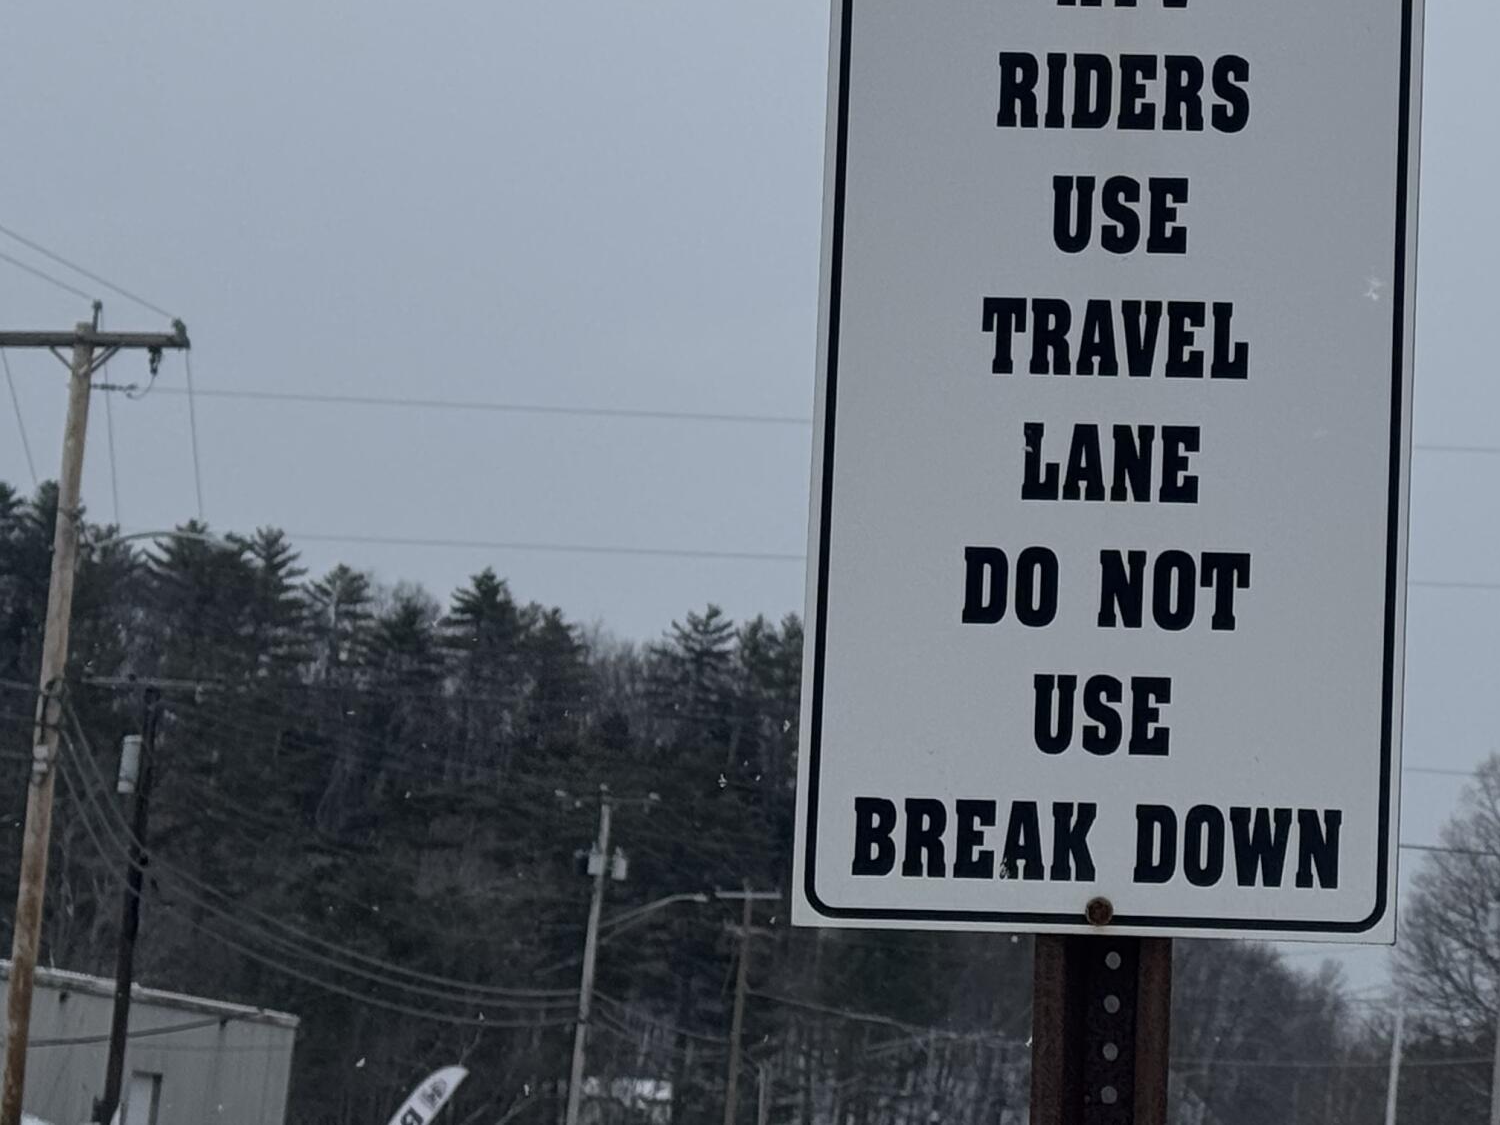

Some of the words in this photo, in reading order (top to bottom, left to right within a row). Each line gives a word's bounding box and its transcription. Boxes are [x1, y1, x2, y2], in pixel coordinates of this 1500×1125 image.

[996, 51, 1250, 134] RIDERS
[1052, 175, 1189, 255] USE
[981, 296, 1249, 380] TRAVEL
[1021, 422, 1201, 504] LANE
[961, 546, 1059, 628] DO
[1097, 549, 1251, 631] NOT
[1033, 673, 1172, 757] USE
[851, 796, 1097, 882] BREAK
[1132, 803, 1343, 890] DOWN
